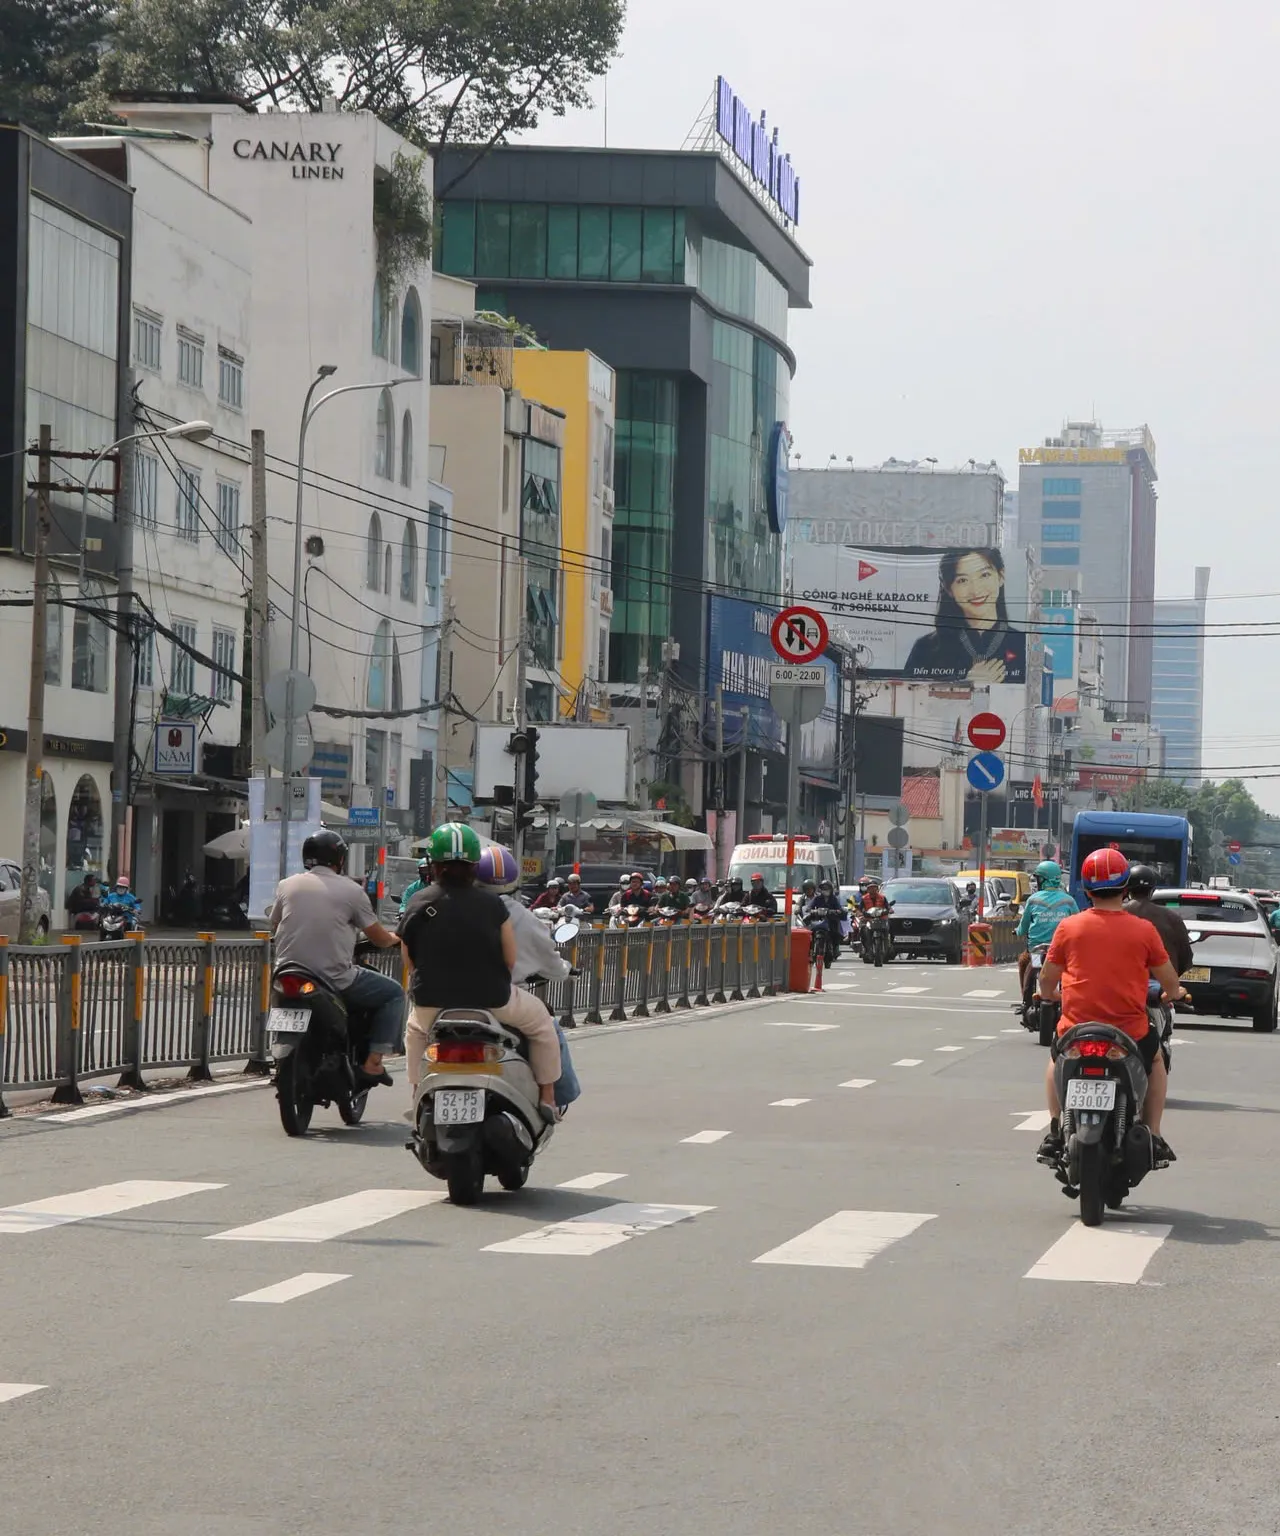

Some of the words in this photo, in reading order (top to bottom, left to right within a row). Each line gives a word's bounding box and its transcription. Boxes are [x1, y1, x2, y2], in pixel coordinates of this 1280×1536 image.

[233, 139, 342, 162] CANARY
[292, 165, 344, 180] LINEN
[802, 589, 837, 600] CÔNG
[876, 593, 929, 602] KARAOKE
[1075, 1082, 1108, 1095] 59-F2
[442, 1091, 477, 1107] 52-P5
[1071, 1095, 1110, 1108] 330.07
[442, 1108, 477, 1122] 9328
